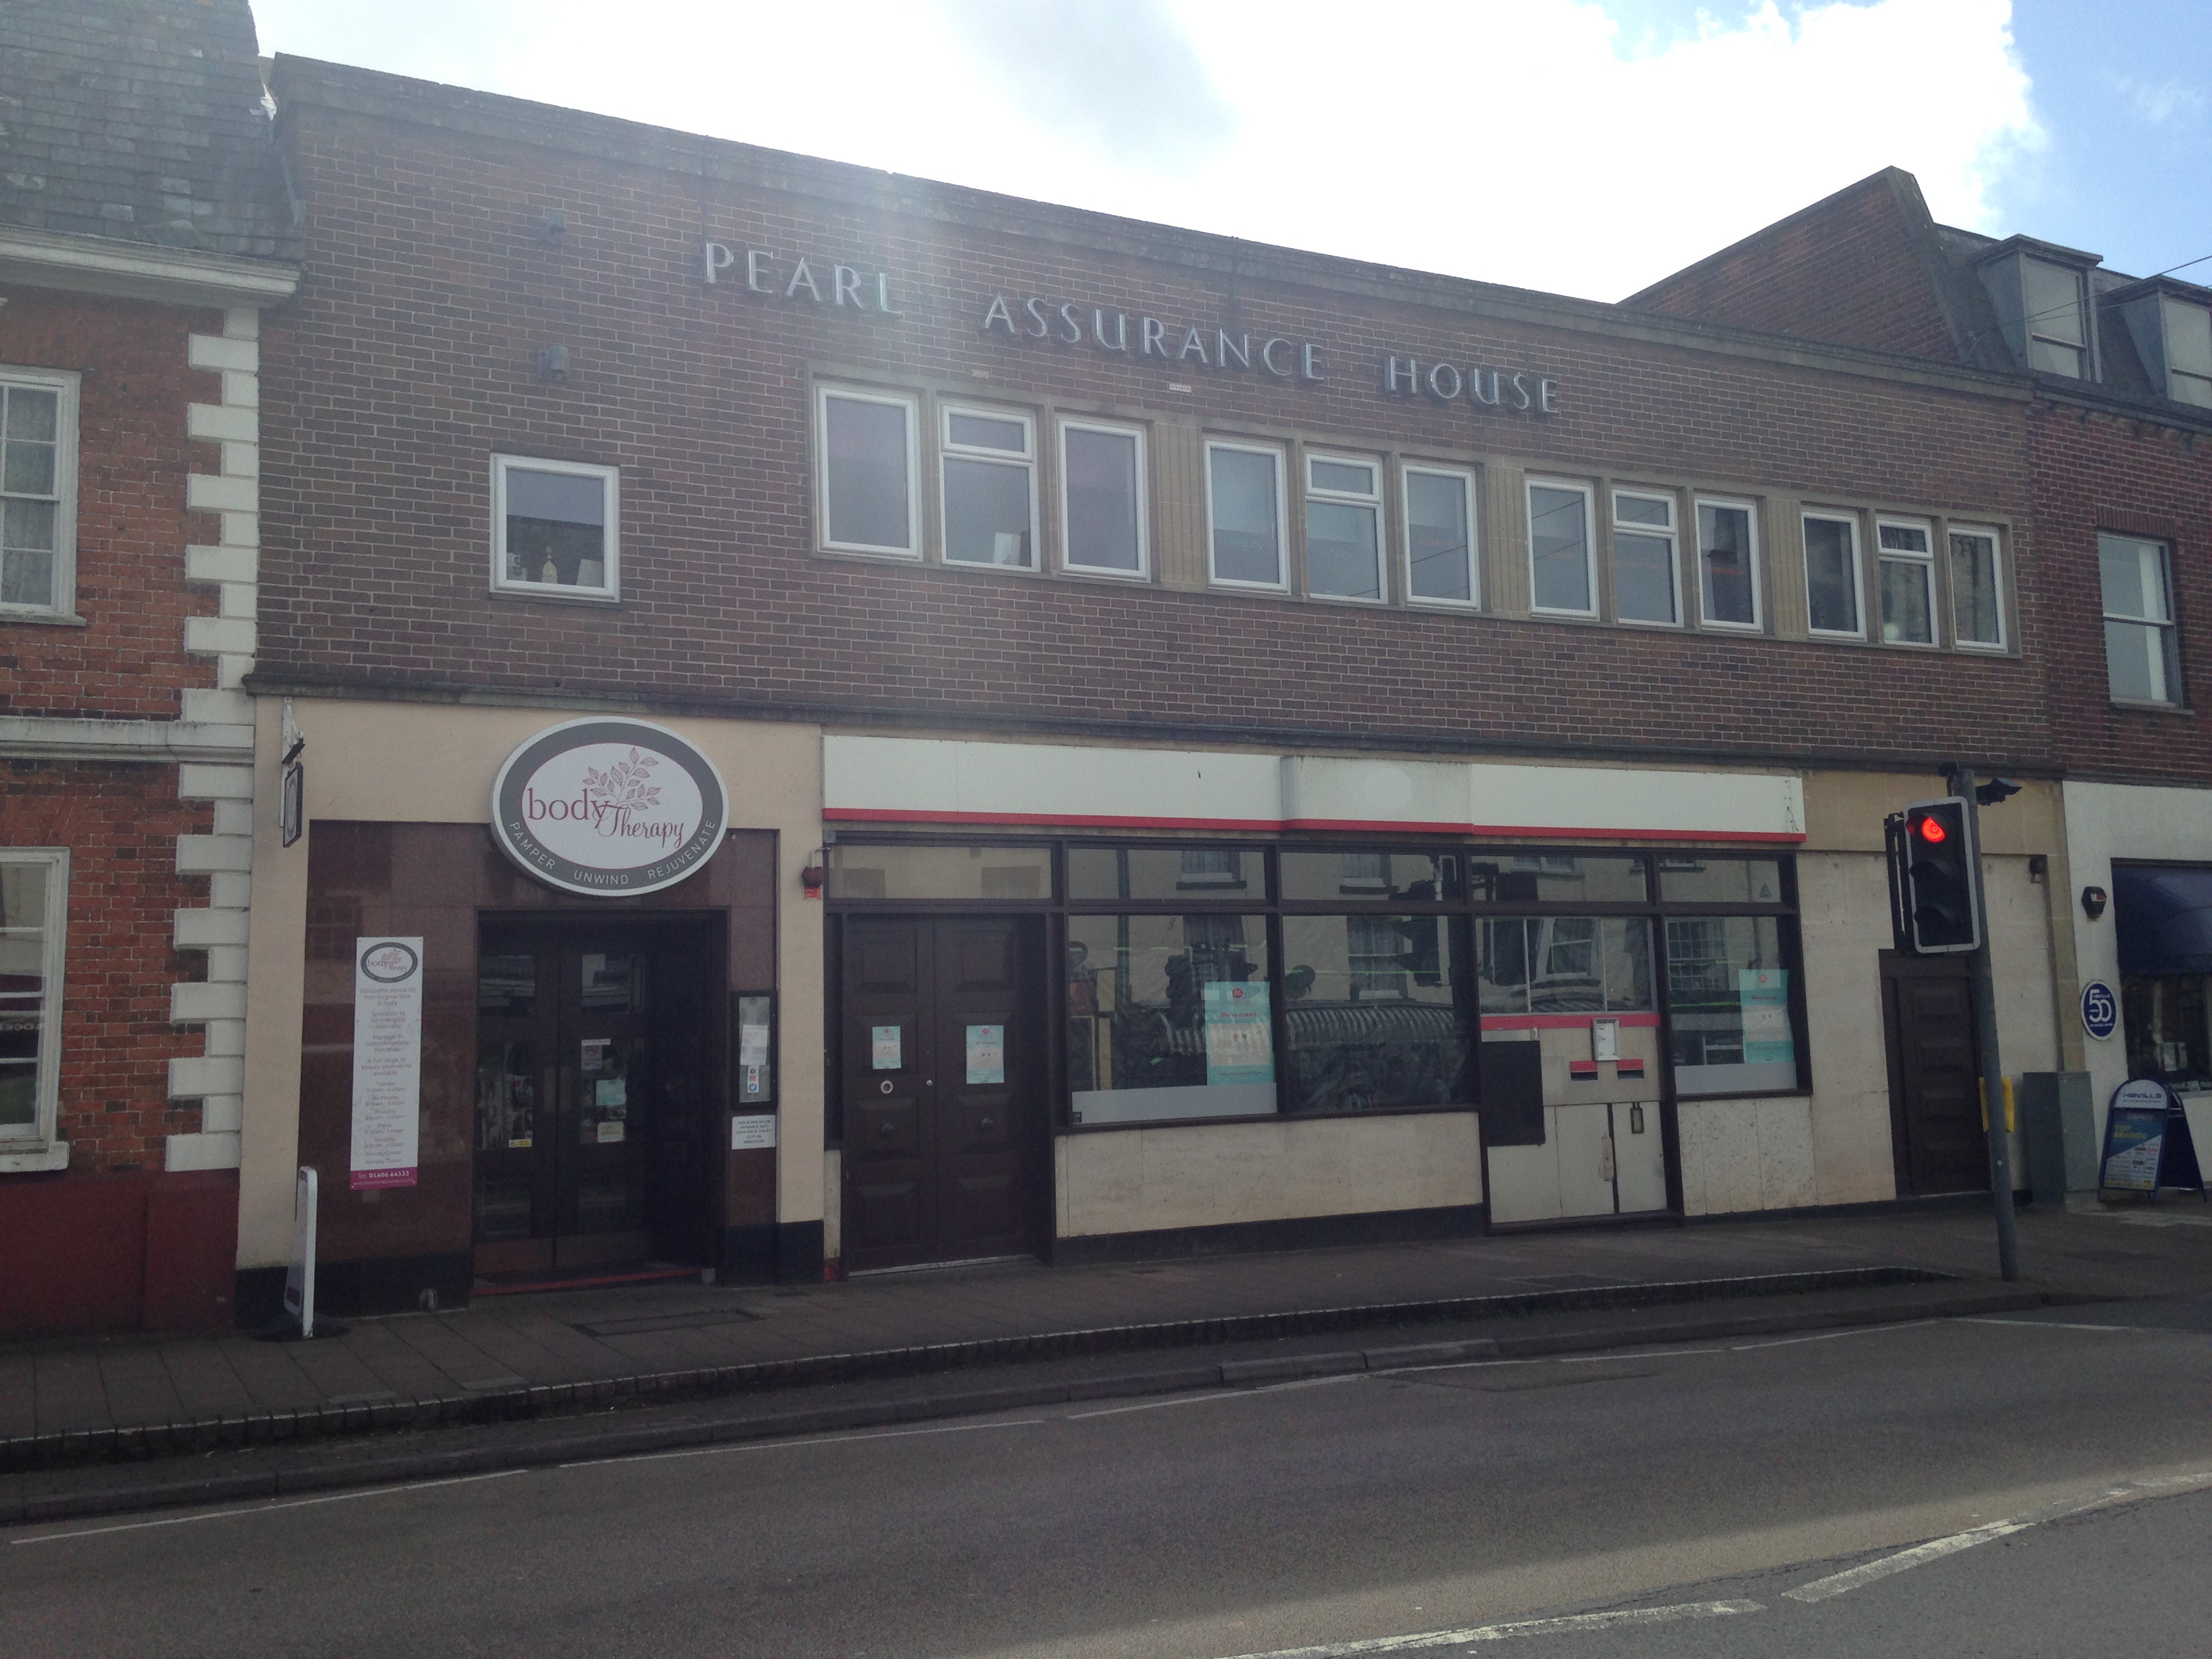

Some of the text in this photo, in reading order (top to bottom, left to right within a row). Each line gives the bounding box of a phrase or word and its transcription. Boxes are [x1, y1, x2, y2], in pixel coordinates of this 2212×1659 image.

[705, 241, 1558, 415] PEARL ASSURANCE HOUSE
[528, 787, 611, 829] body
[593, 803, 684, 848] Therapy
[510, 820, 716, 885] PAMPER UNWIND REJUVENATE
